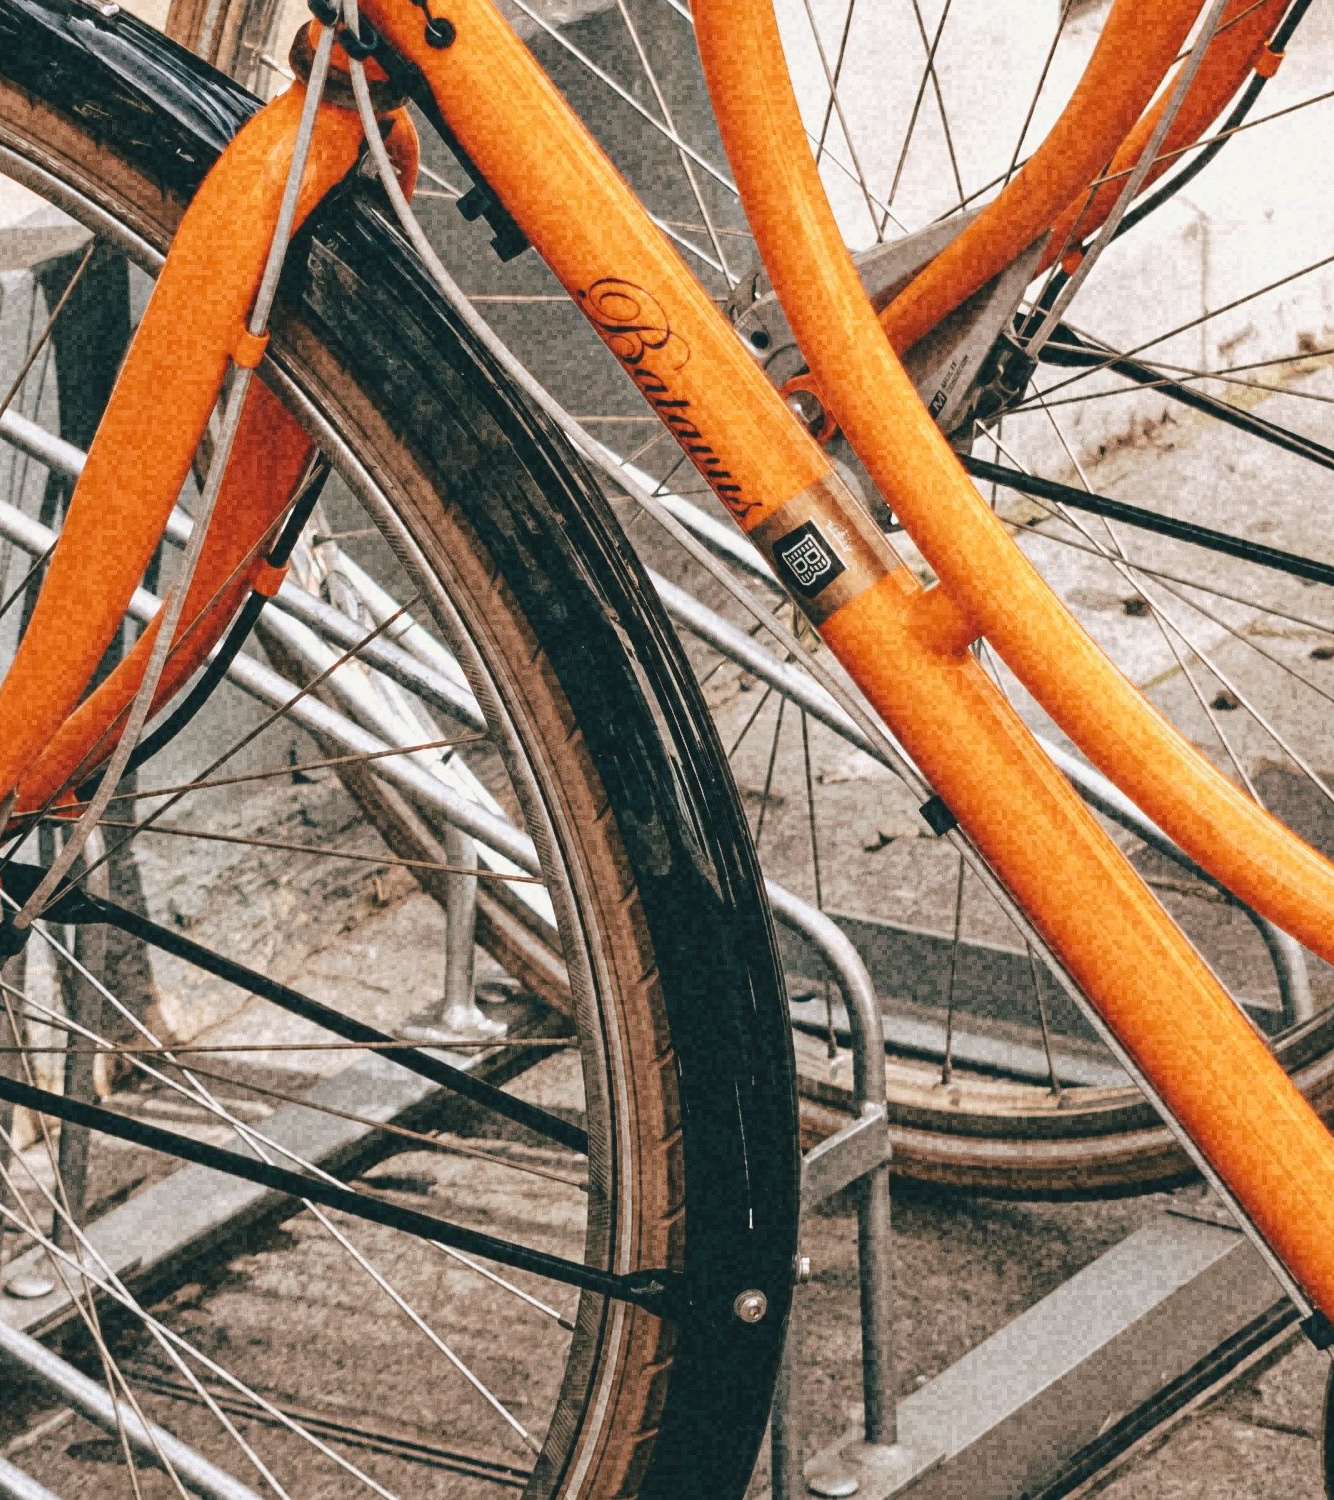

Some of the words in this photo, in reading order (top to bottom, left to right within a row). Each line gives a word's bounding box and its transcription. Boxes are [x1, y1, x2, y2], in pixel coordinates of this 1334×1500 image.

[576, 277, 764, 520] Batavus
[932, 389, 946, 412] M
[780, 533, 832, 588] B
